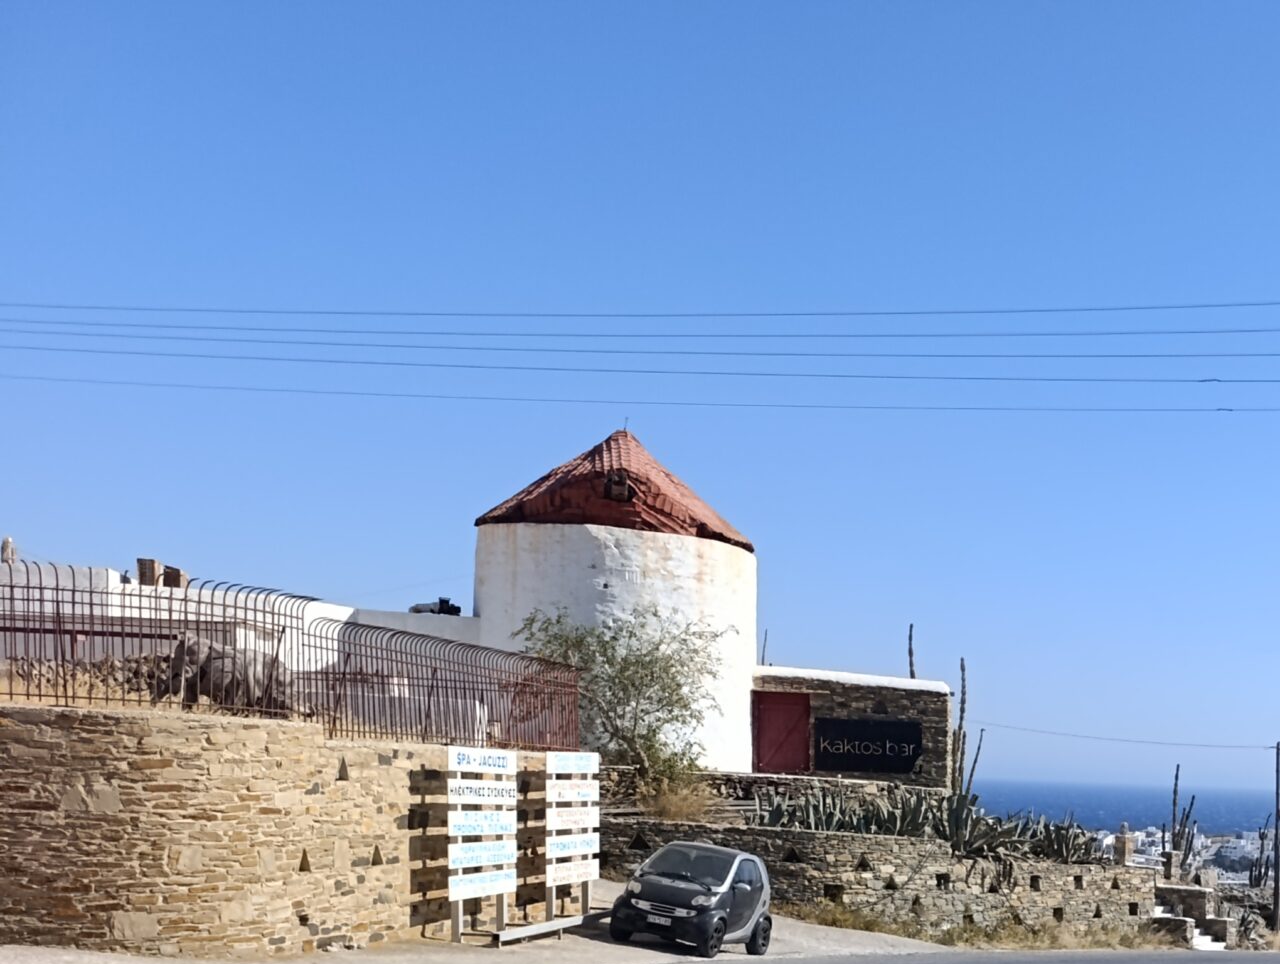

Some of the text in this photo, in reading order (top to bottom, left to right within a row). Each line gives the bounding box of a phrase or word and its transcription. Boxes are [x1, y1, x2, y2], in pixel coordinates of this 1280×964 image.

[886, 739, 916, 757] bar
[456, 752, 472, 767] SPA
[478, 754, 508, 769] JACUZZI
